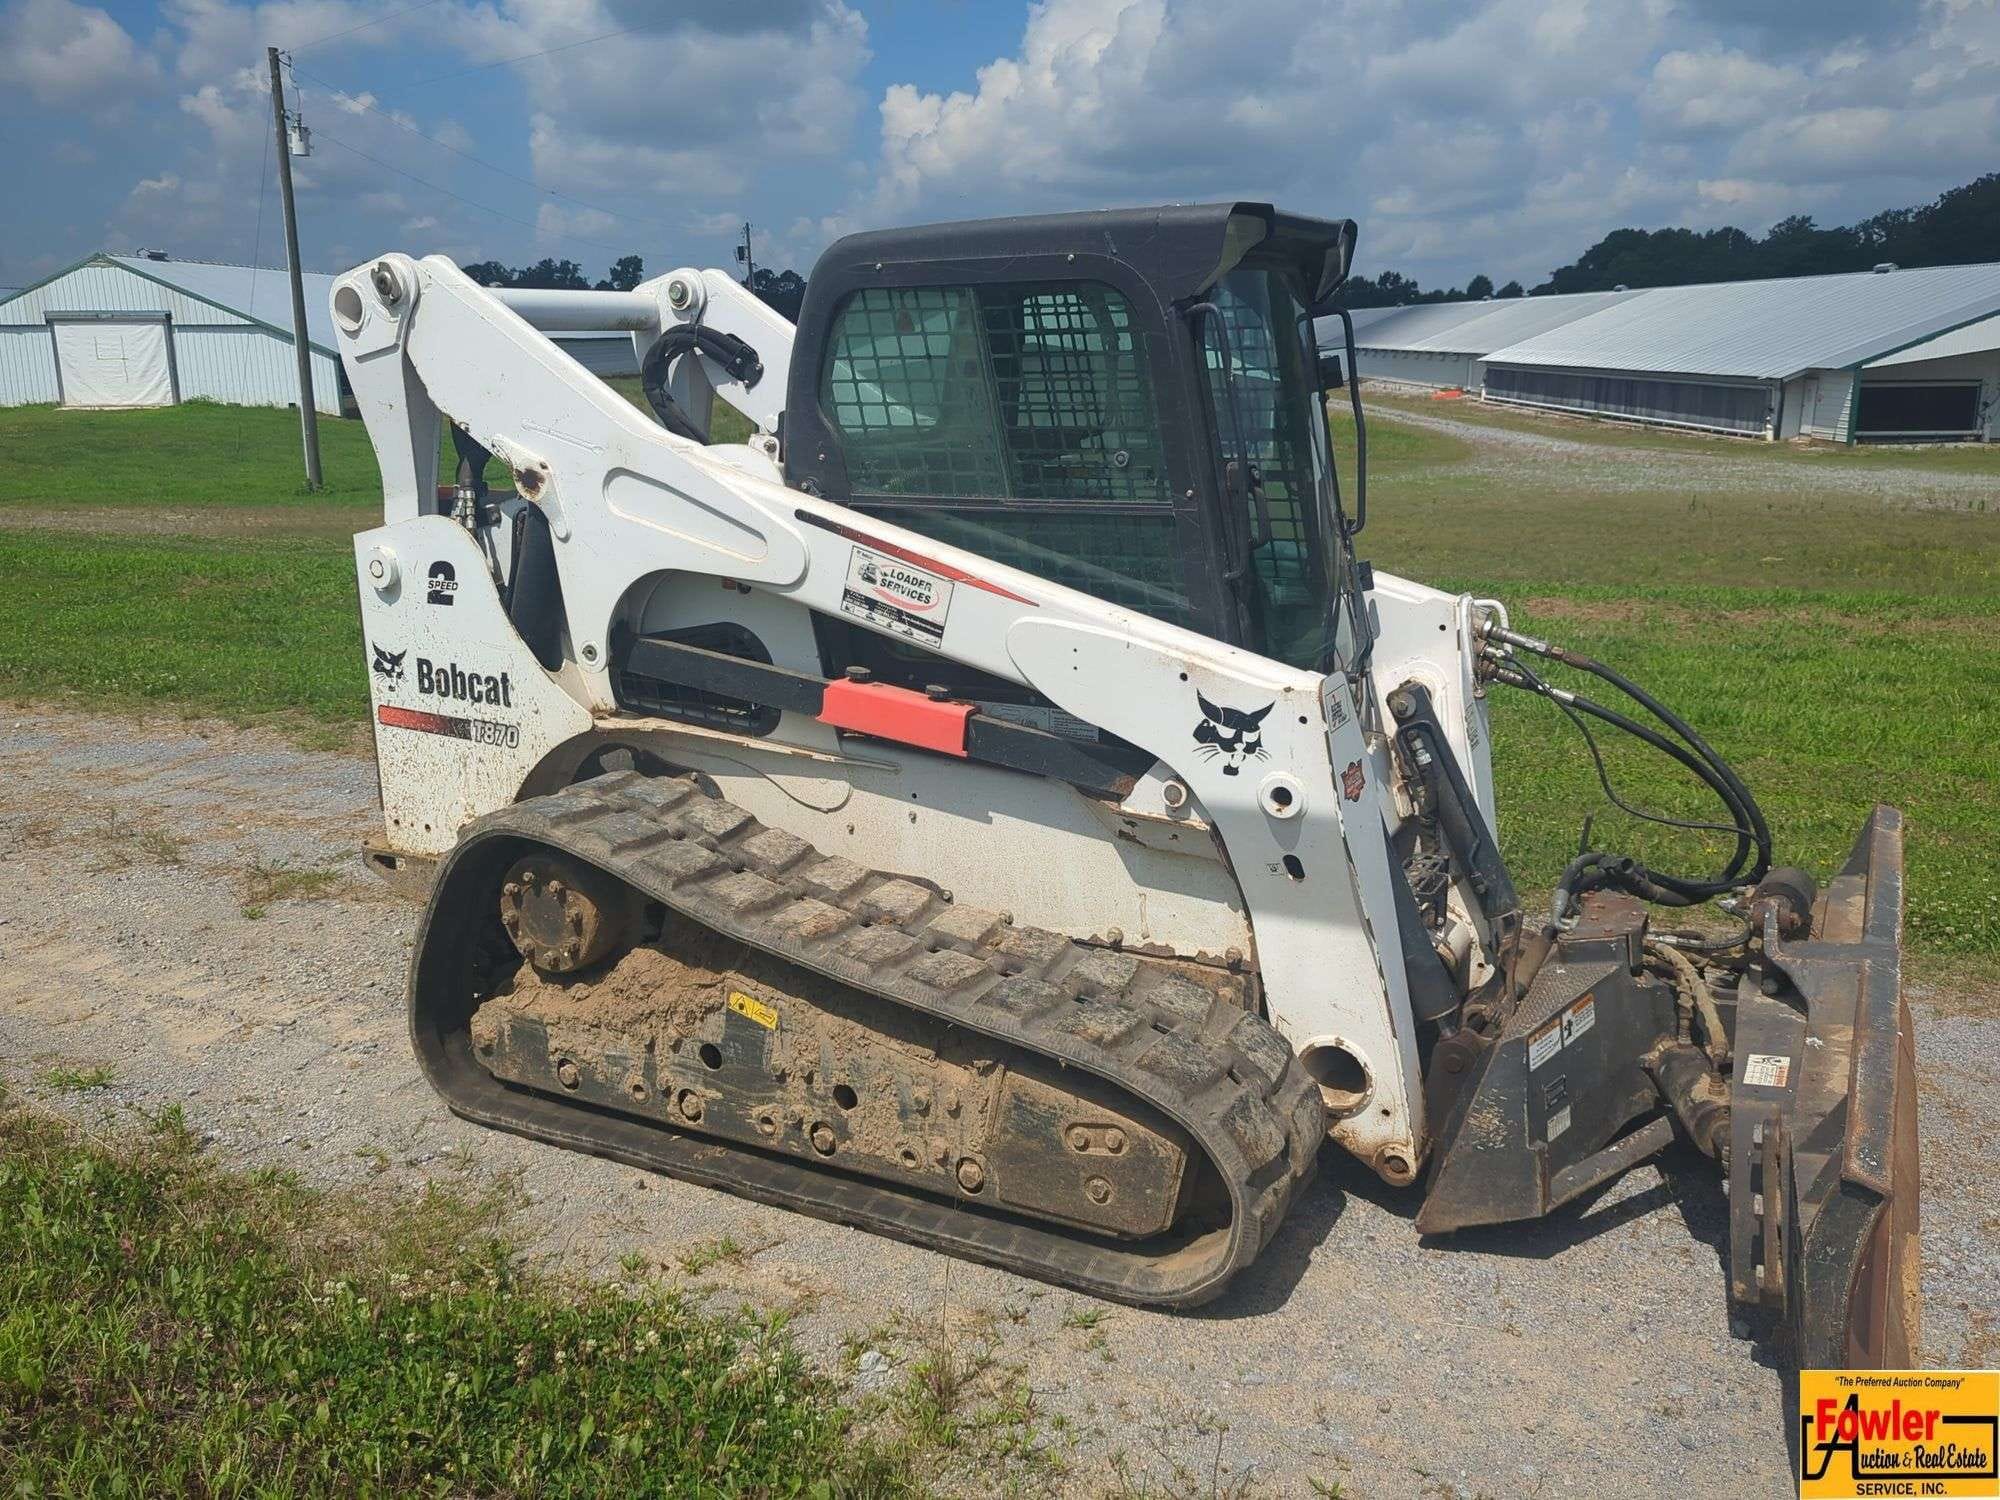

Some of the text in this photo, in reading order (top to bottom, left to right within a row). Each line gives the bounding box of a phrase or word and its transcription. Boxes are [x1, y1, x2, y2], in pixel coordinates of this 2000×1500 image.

[427, 560, 456, 606] 2
[427, 579, 459, 591] SPEED
[879, 578, 932, 605] SERVICES
[889, 568, 932, 592] LOADER
[416, 657, 512, 708] Bobcat
[473, 718, 520, 749] T870
